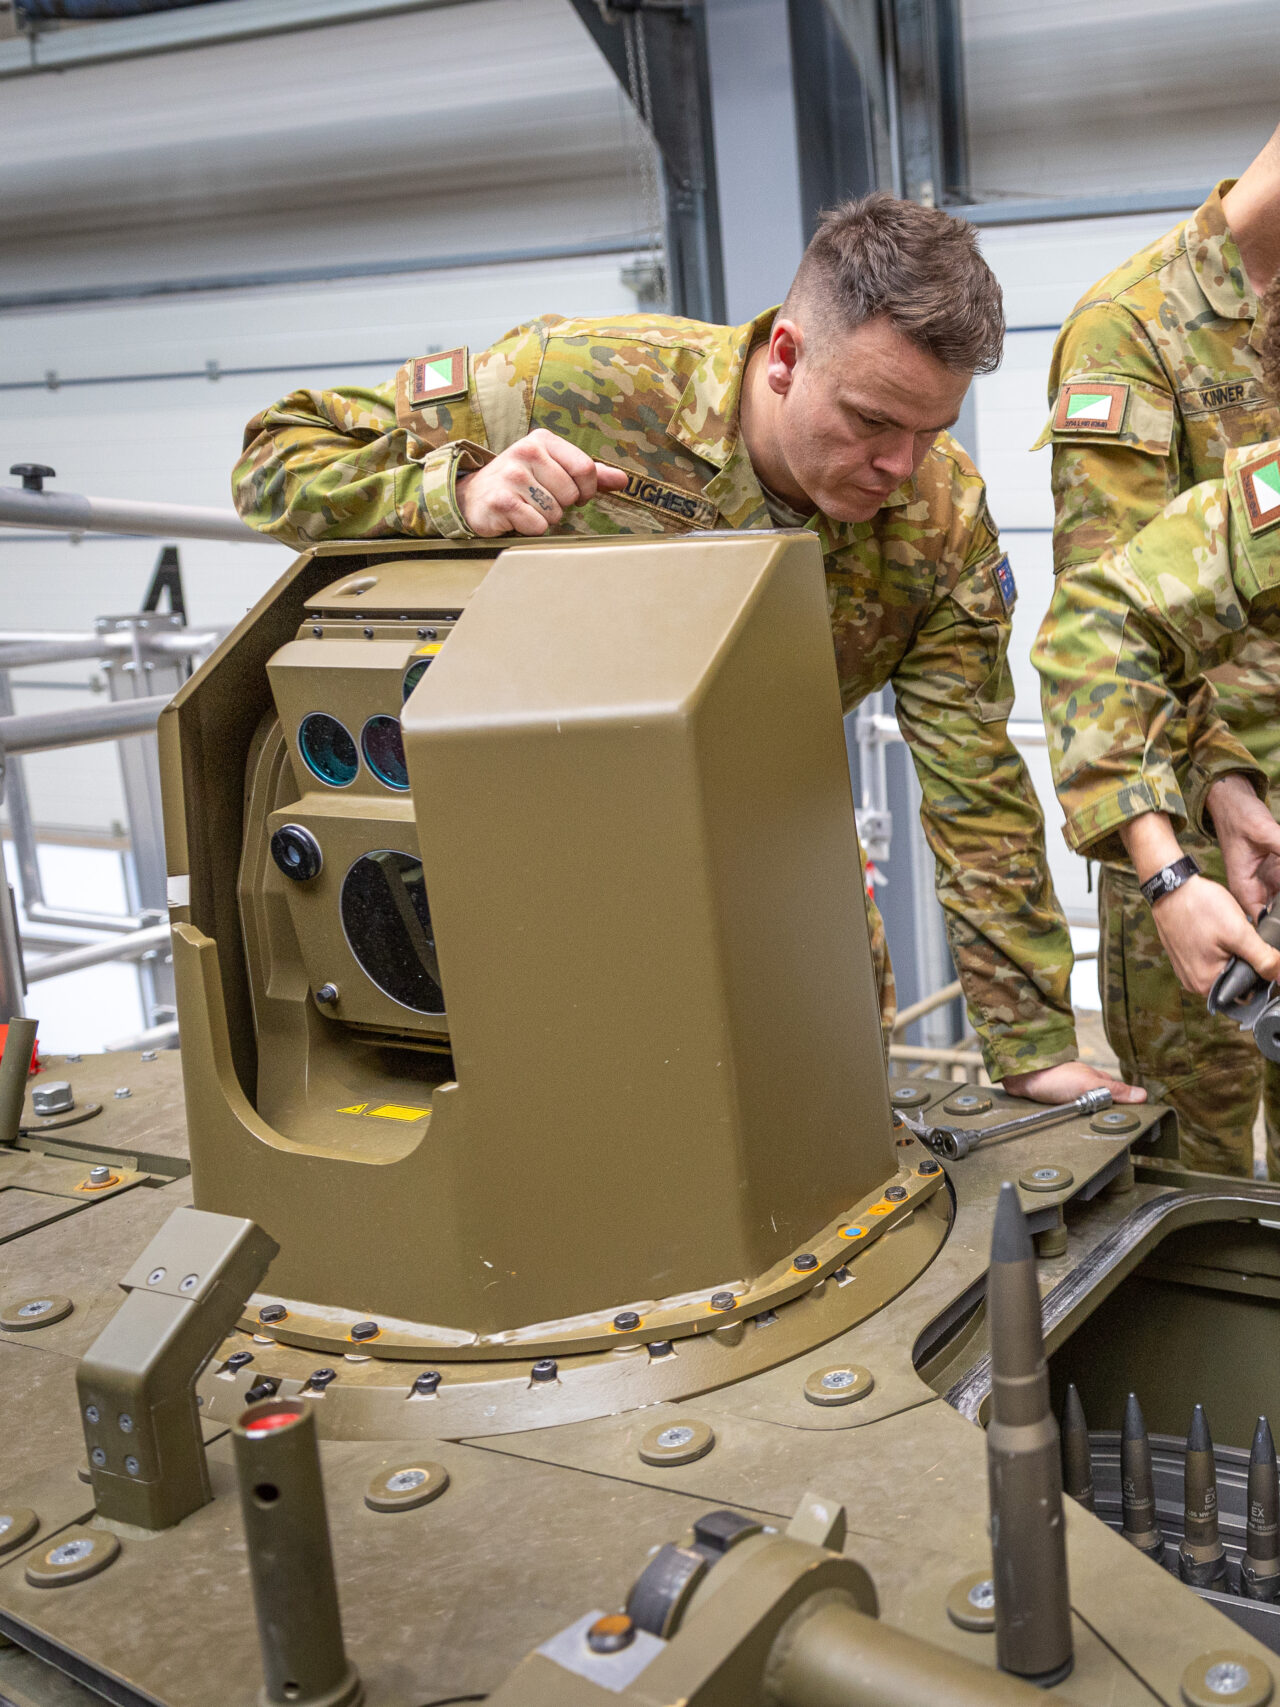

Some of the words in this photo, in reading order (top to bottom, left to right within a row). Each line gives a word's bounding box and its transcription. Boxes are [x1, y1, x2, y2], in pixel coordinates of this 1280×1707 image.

[1200, 385, 1244, 407] KINNER
[621, 476, 697, 519] UGHES
[1251, 1507, 1264, 1518] EX
